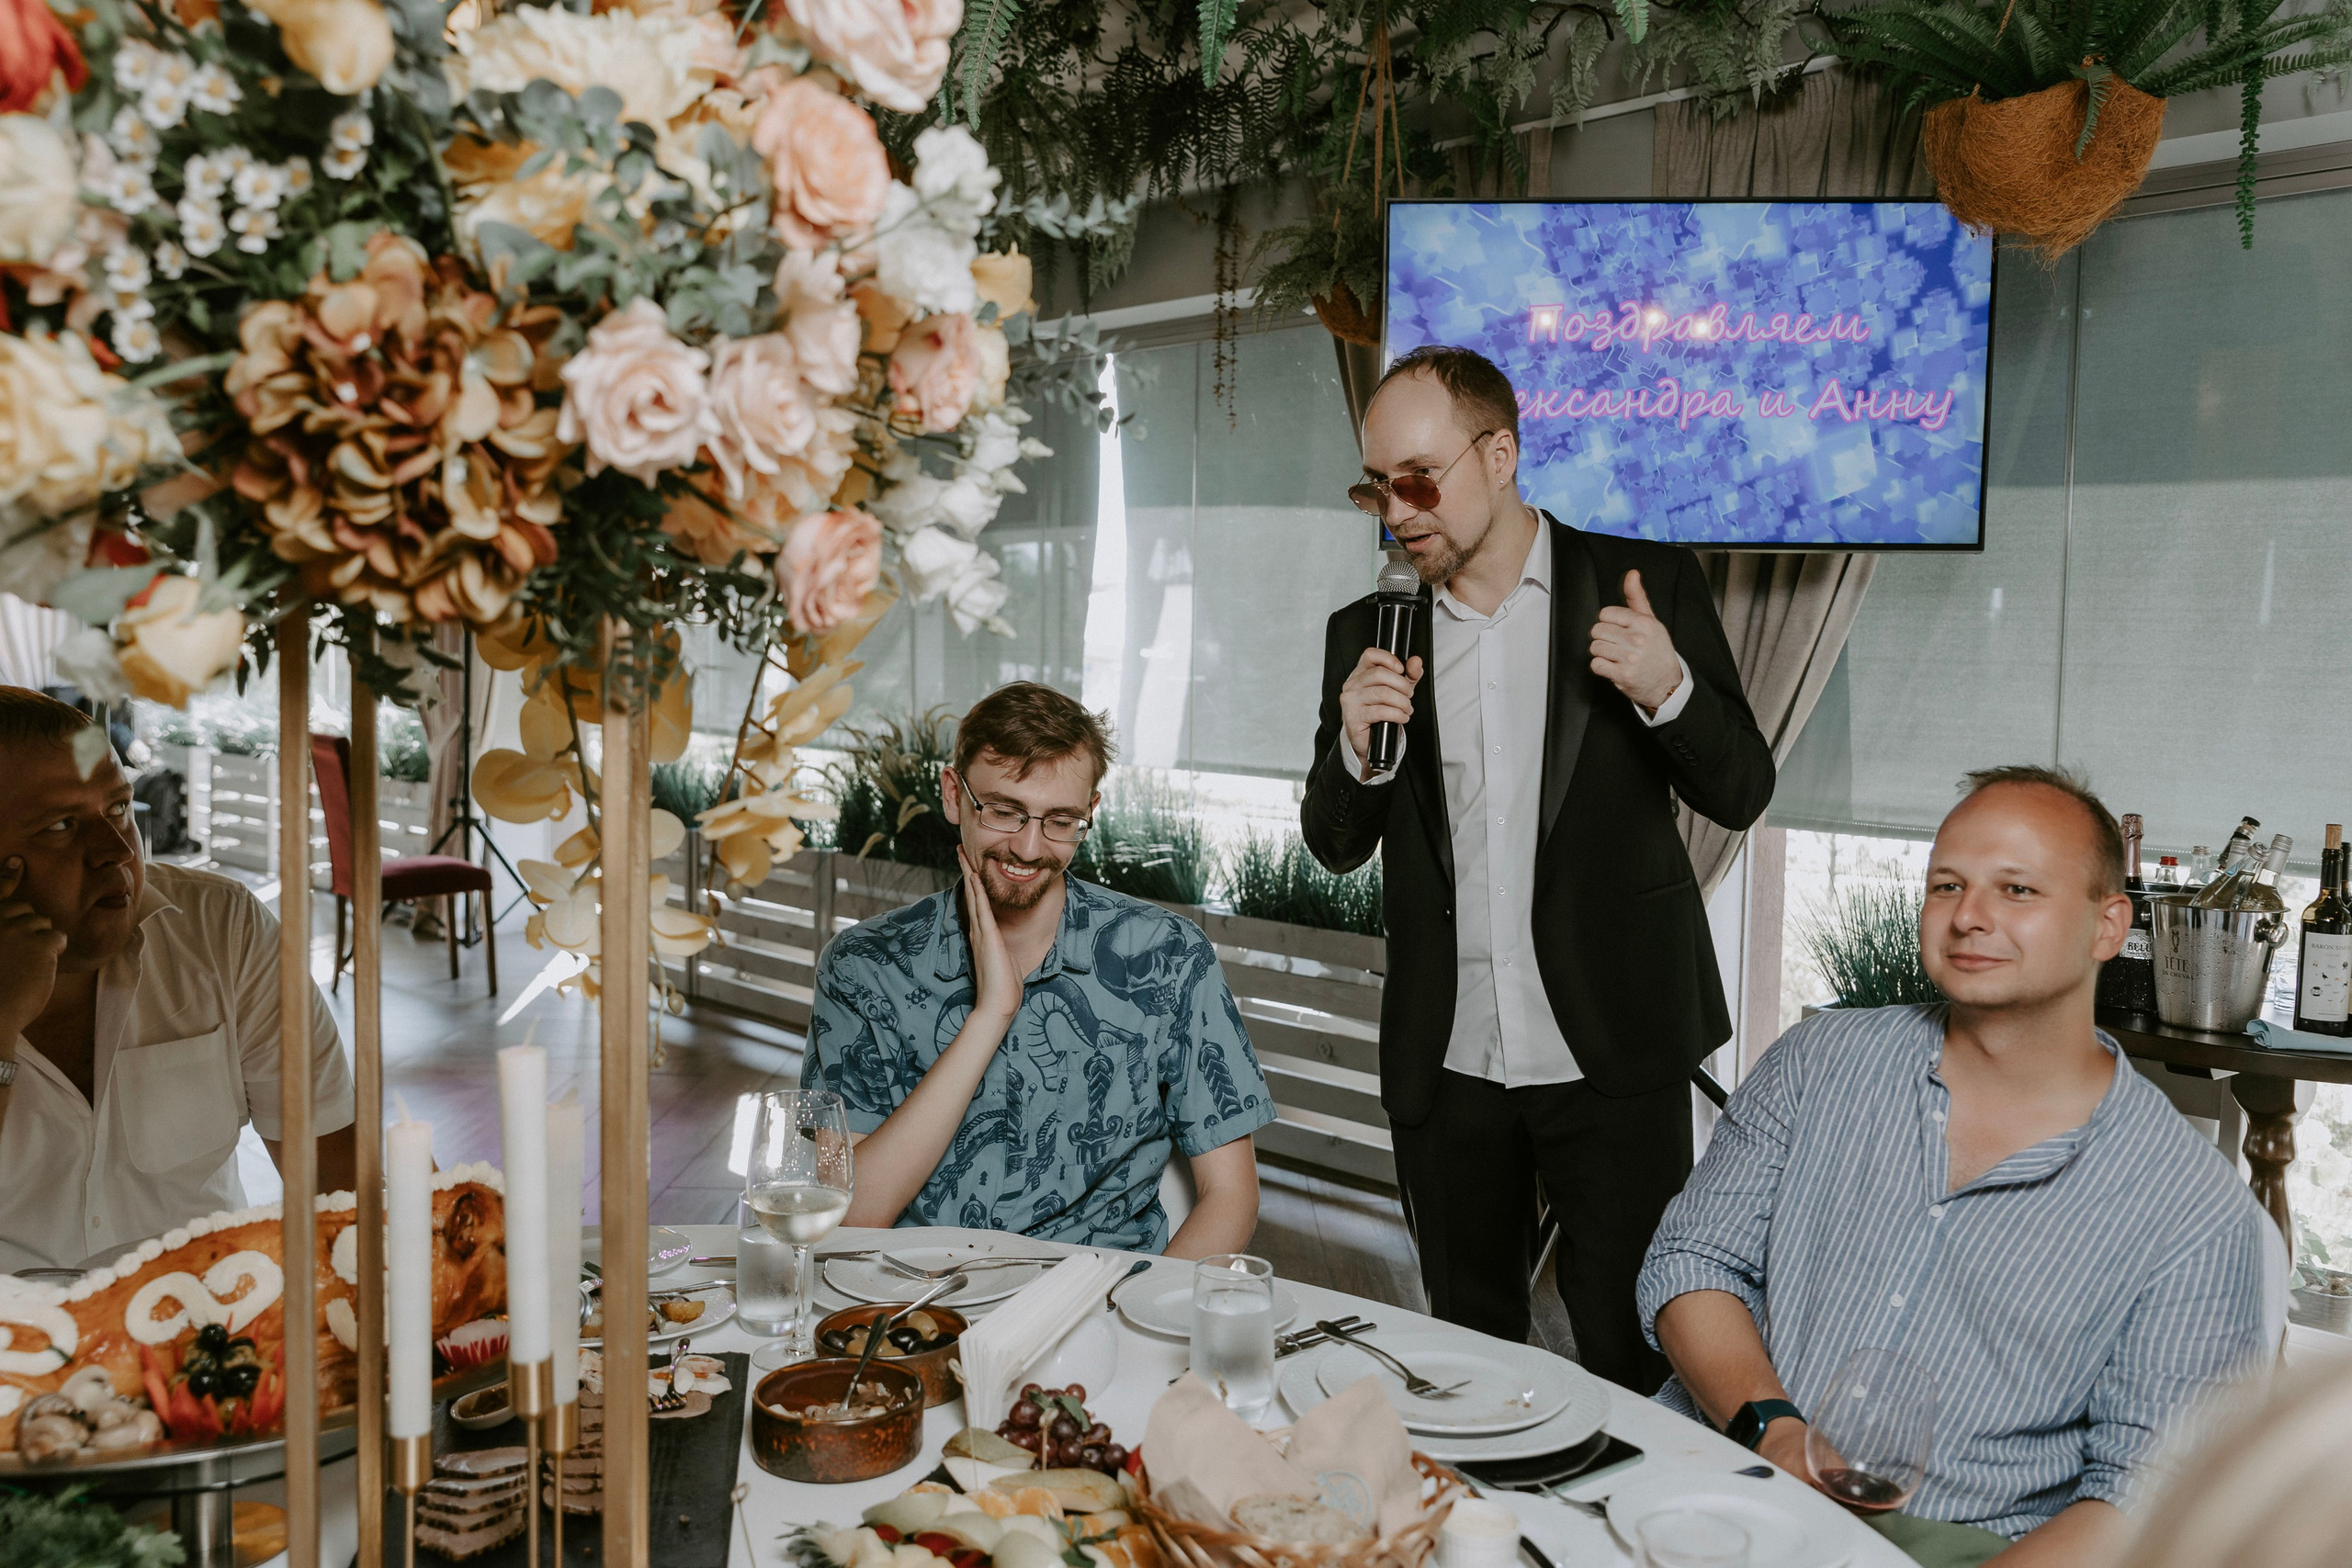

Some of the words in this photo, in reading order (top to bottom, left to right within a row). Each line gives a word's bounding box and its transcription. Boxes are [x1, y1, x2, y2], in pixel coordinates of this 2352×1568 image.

[1528, 300, 1871, 353] Поздравляем
[1516, 378, 1744, 429] ександра
[1758, 390, 1794, 419] и
[1807, 378, 1954, 431] Анну
[2127, 942, 2152, 953] BELU
